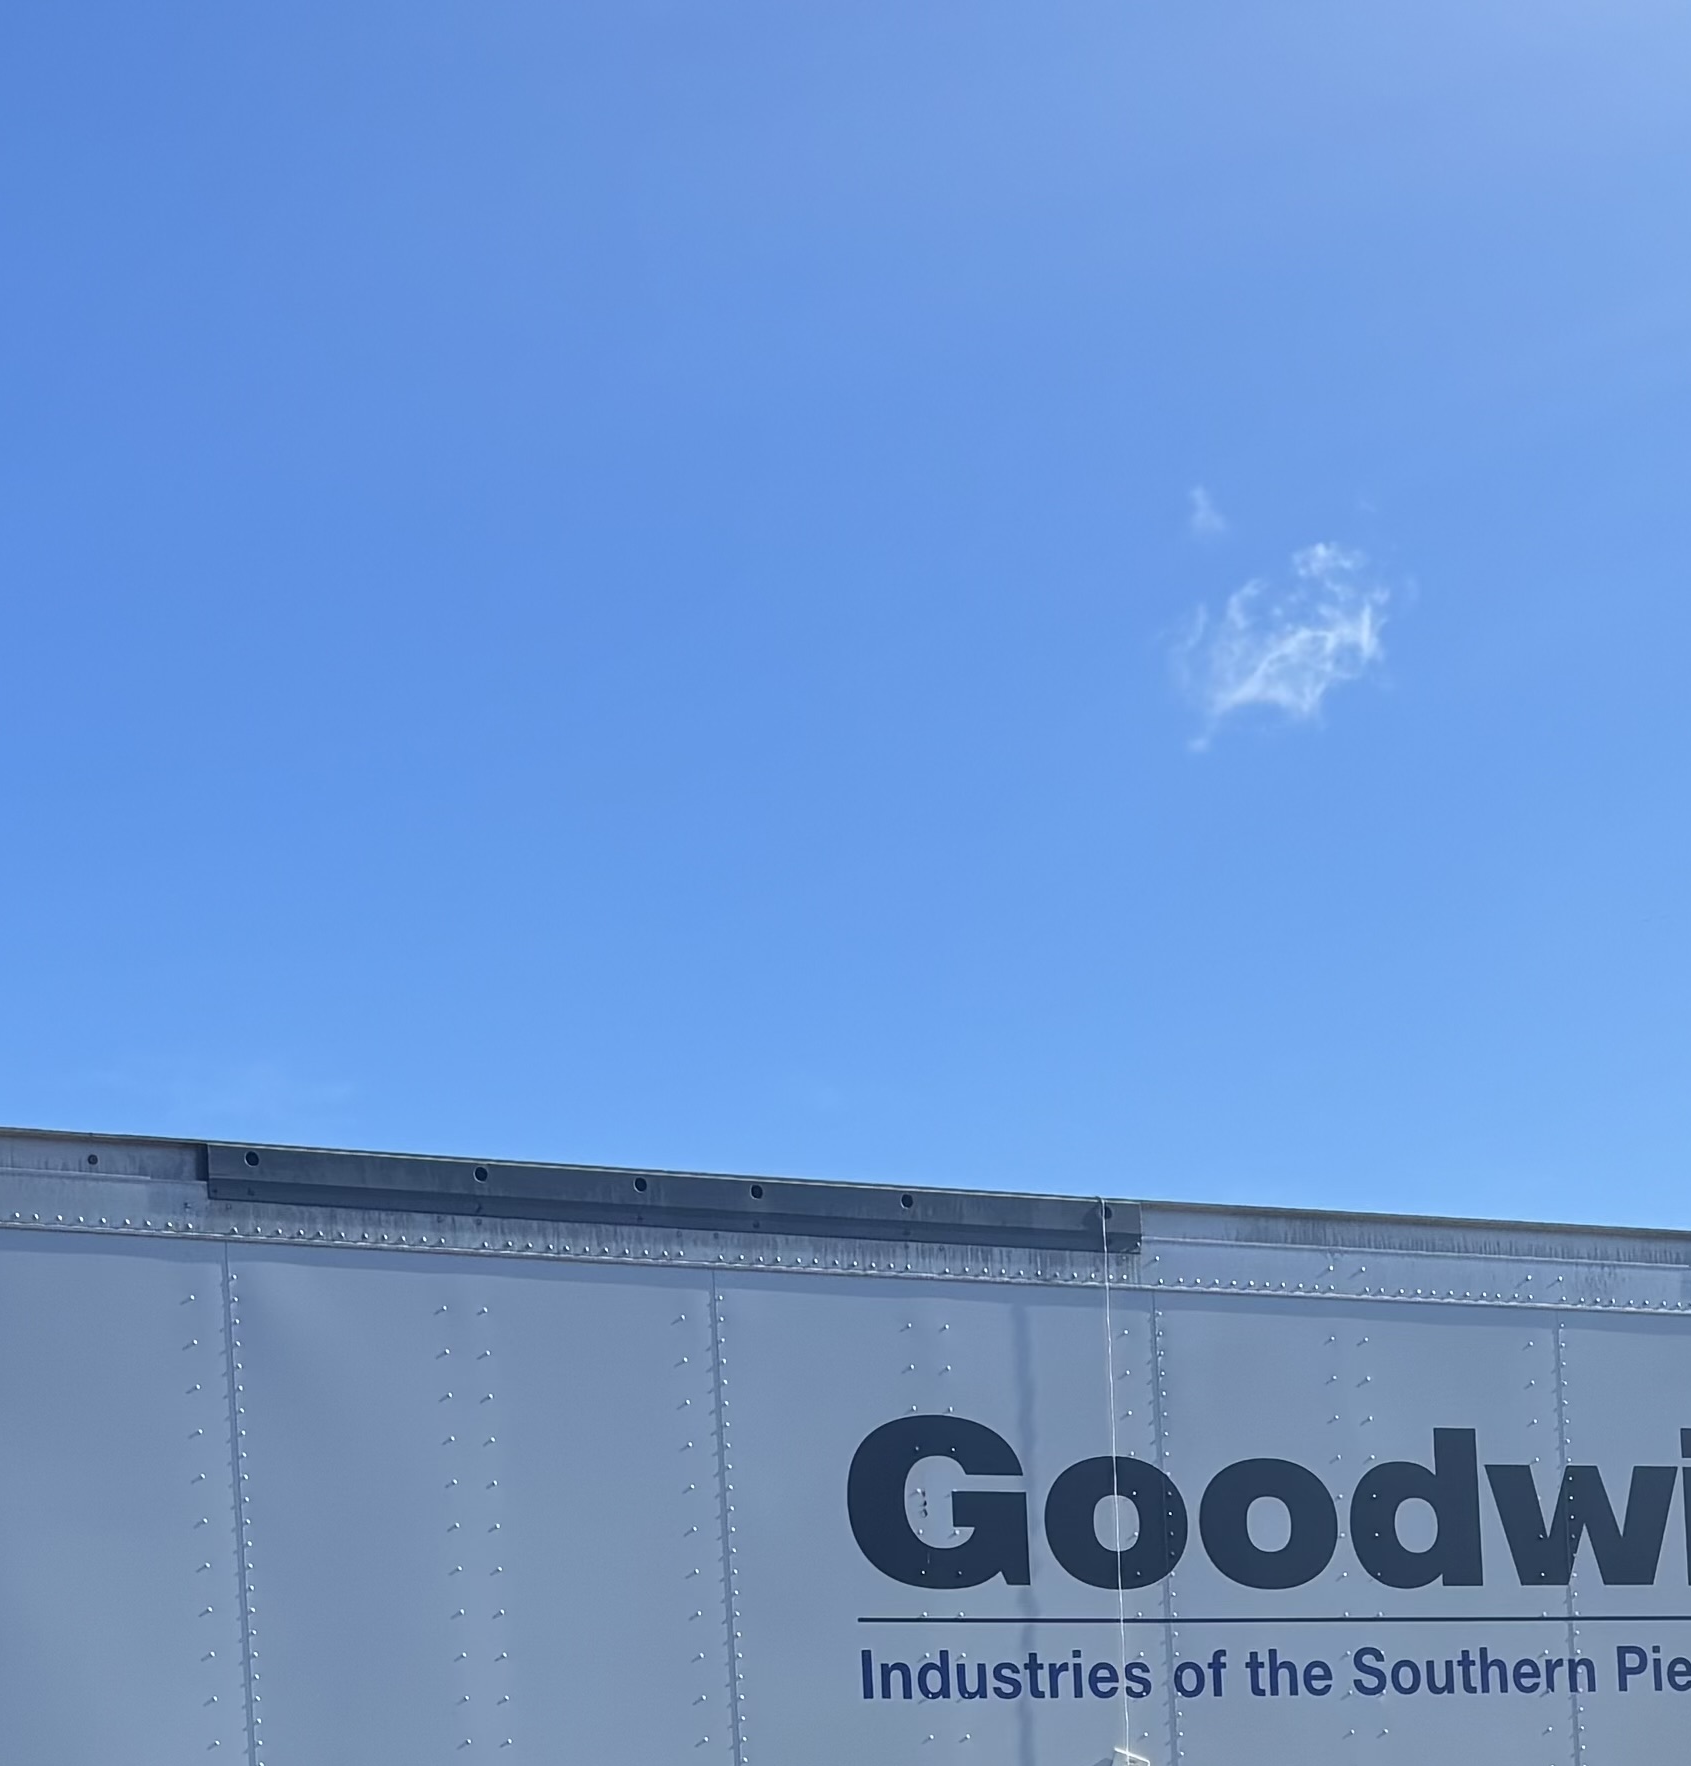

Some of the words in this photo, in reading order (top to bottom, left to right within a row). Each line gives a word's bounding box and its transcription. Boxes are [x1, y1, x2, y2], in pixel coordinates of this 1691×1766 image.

[861, 1648, 1151, 1699] Industries
[1174, 1648, 1226, 1698] of
[1245, 1648, 1332, 1697] the
[1353, 1646, 1596, 1695] Southern
